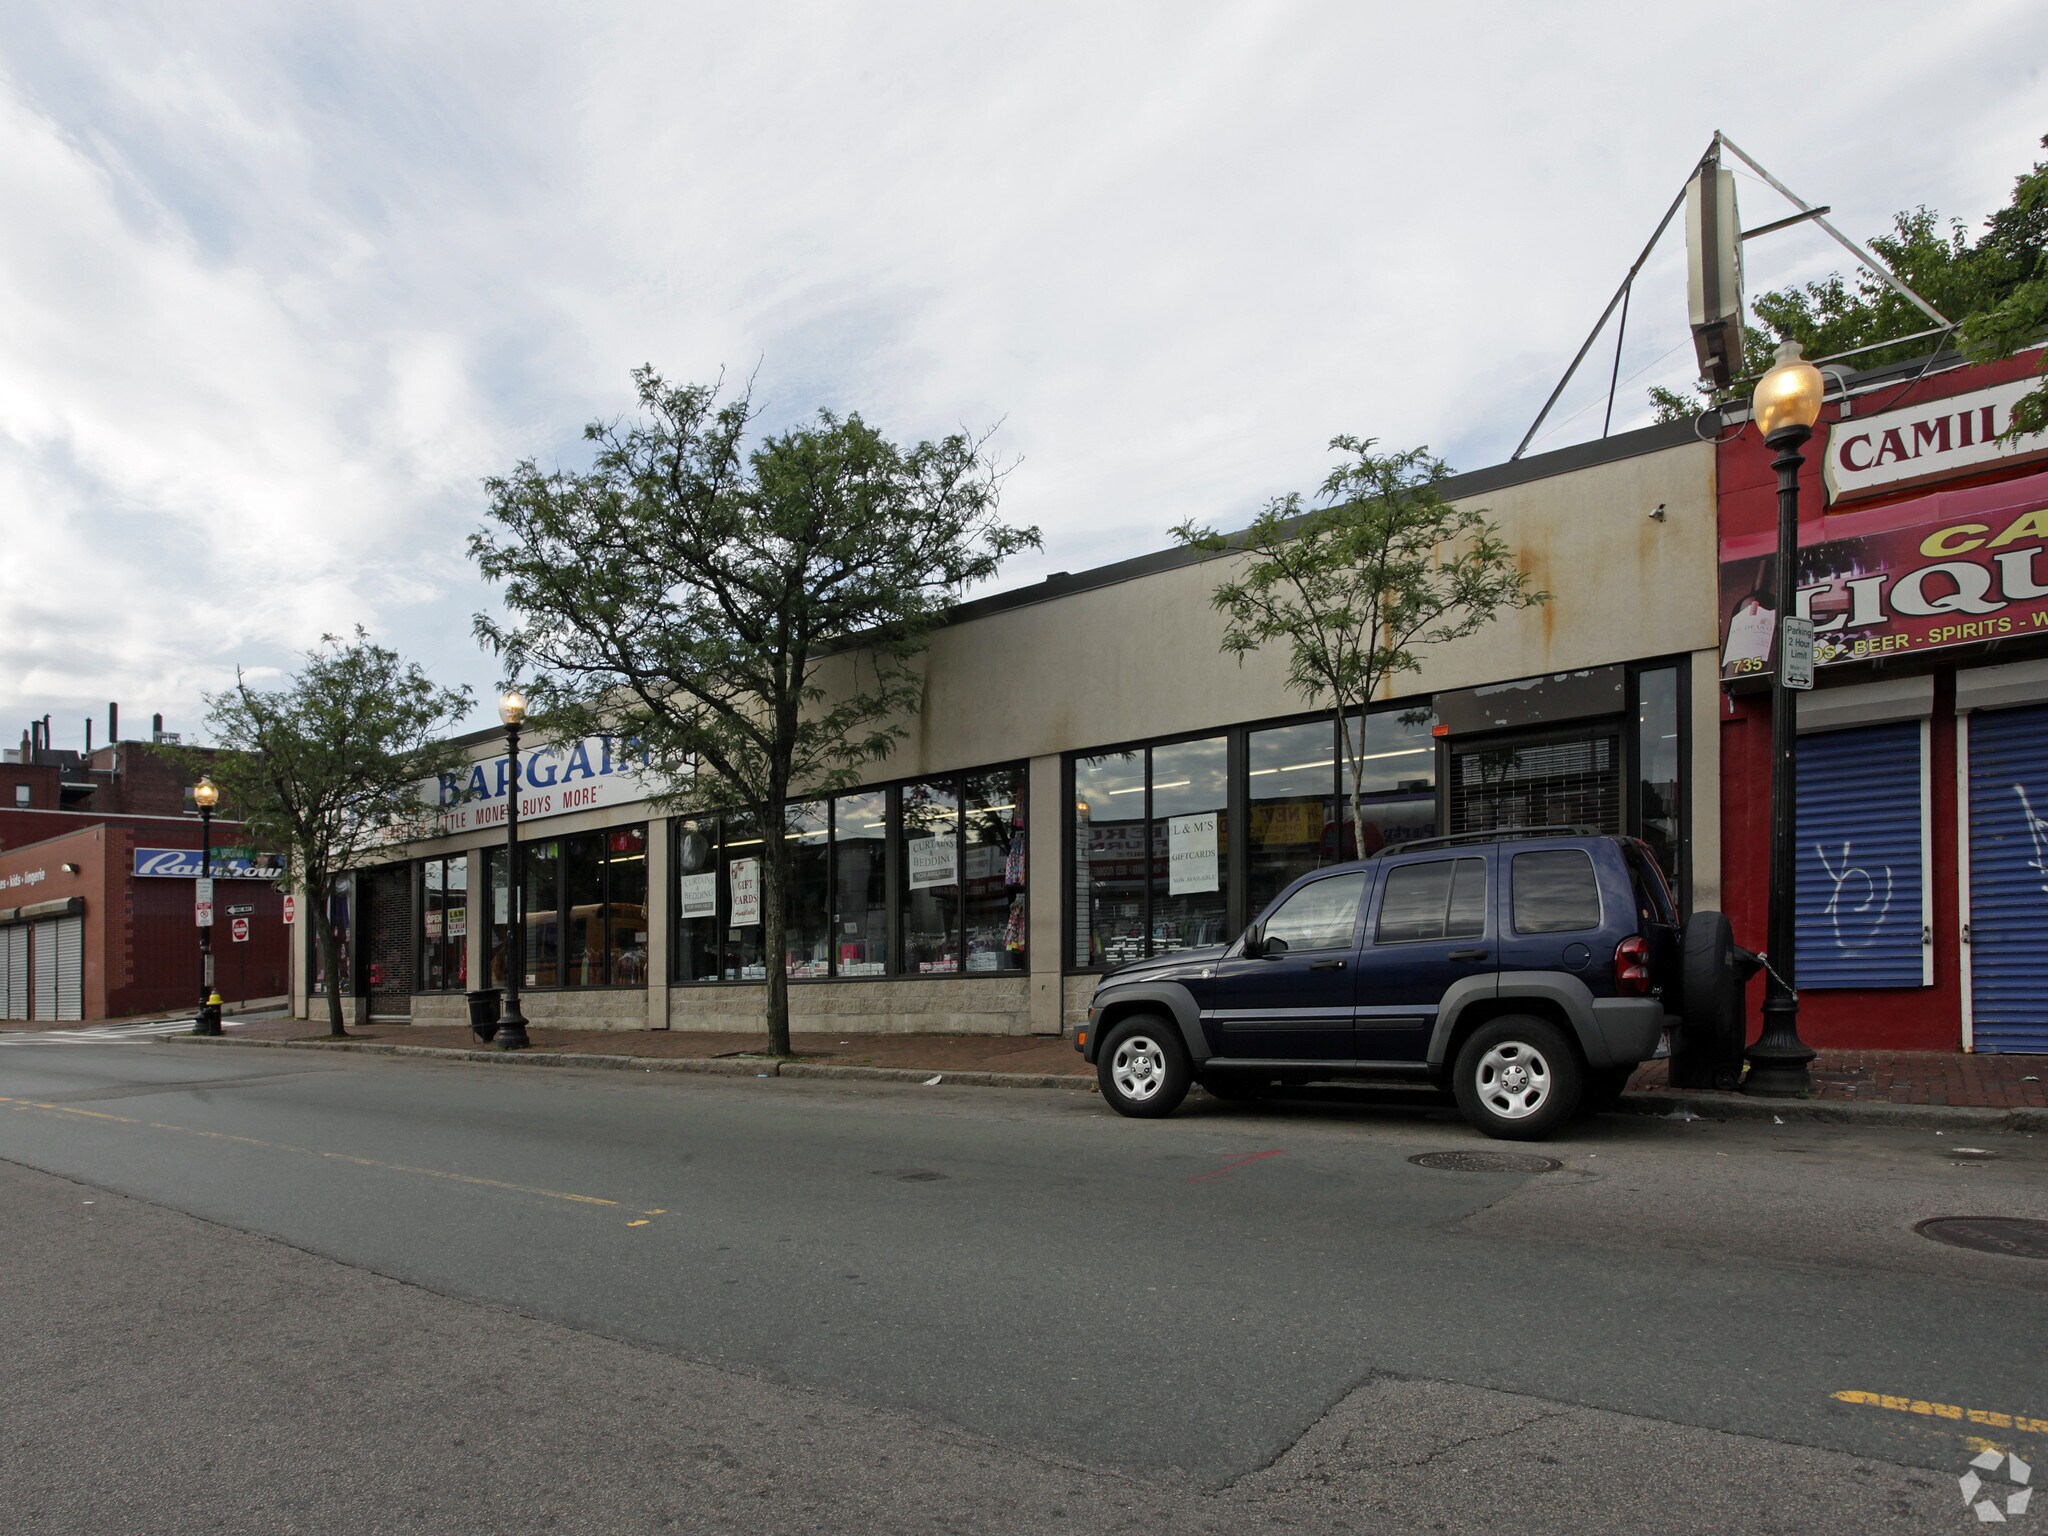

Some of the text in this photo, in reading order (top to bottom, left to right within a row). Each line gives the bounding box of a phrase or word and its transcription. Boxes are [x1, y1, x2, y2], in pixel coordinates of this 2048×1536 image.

[1839, 404, 2044, 472] CAMIL
[1787, 625, 1811, 639] Parking
[1854, 633, 1910, 655] BEER
[1928, 617, 2012, 643] SPIRITS
[1788, 637, 1810, 648] 2 Hour
[1791, 649, 1807, 660] Limit
[1732, 656, 1762, 674] 735
[522, 795, 551, 817] BUYS
[1173, 825, 1181, 835] L
[1182, 823, 1191, 834] &
[913, 838, 954, 853] CURTAINS
[913, 852, 954, 867] BEDDING
[1172, 850, 1216, 861] GIFTCARDS
[928, 870, 950, 878] AVAILABLE
[1186, 874, 1216, 882] AVAILABLE
[684, 876, 714, 888] CURTAINS
[737, 879, 753, 891] GIFT
[684, 889, 714, 901] BEDDING
[734, 894, 758, 906] CARDS
